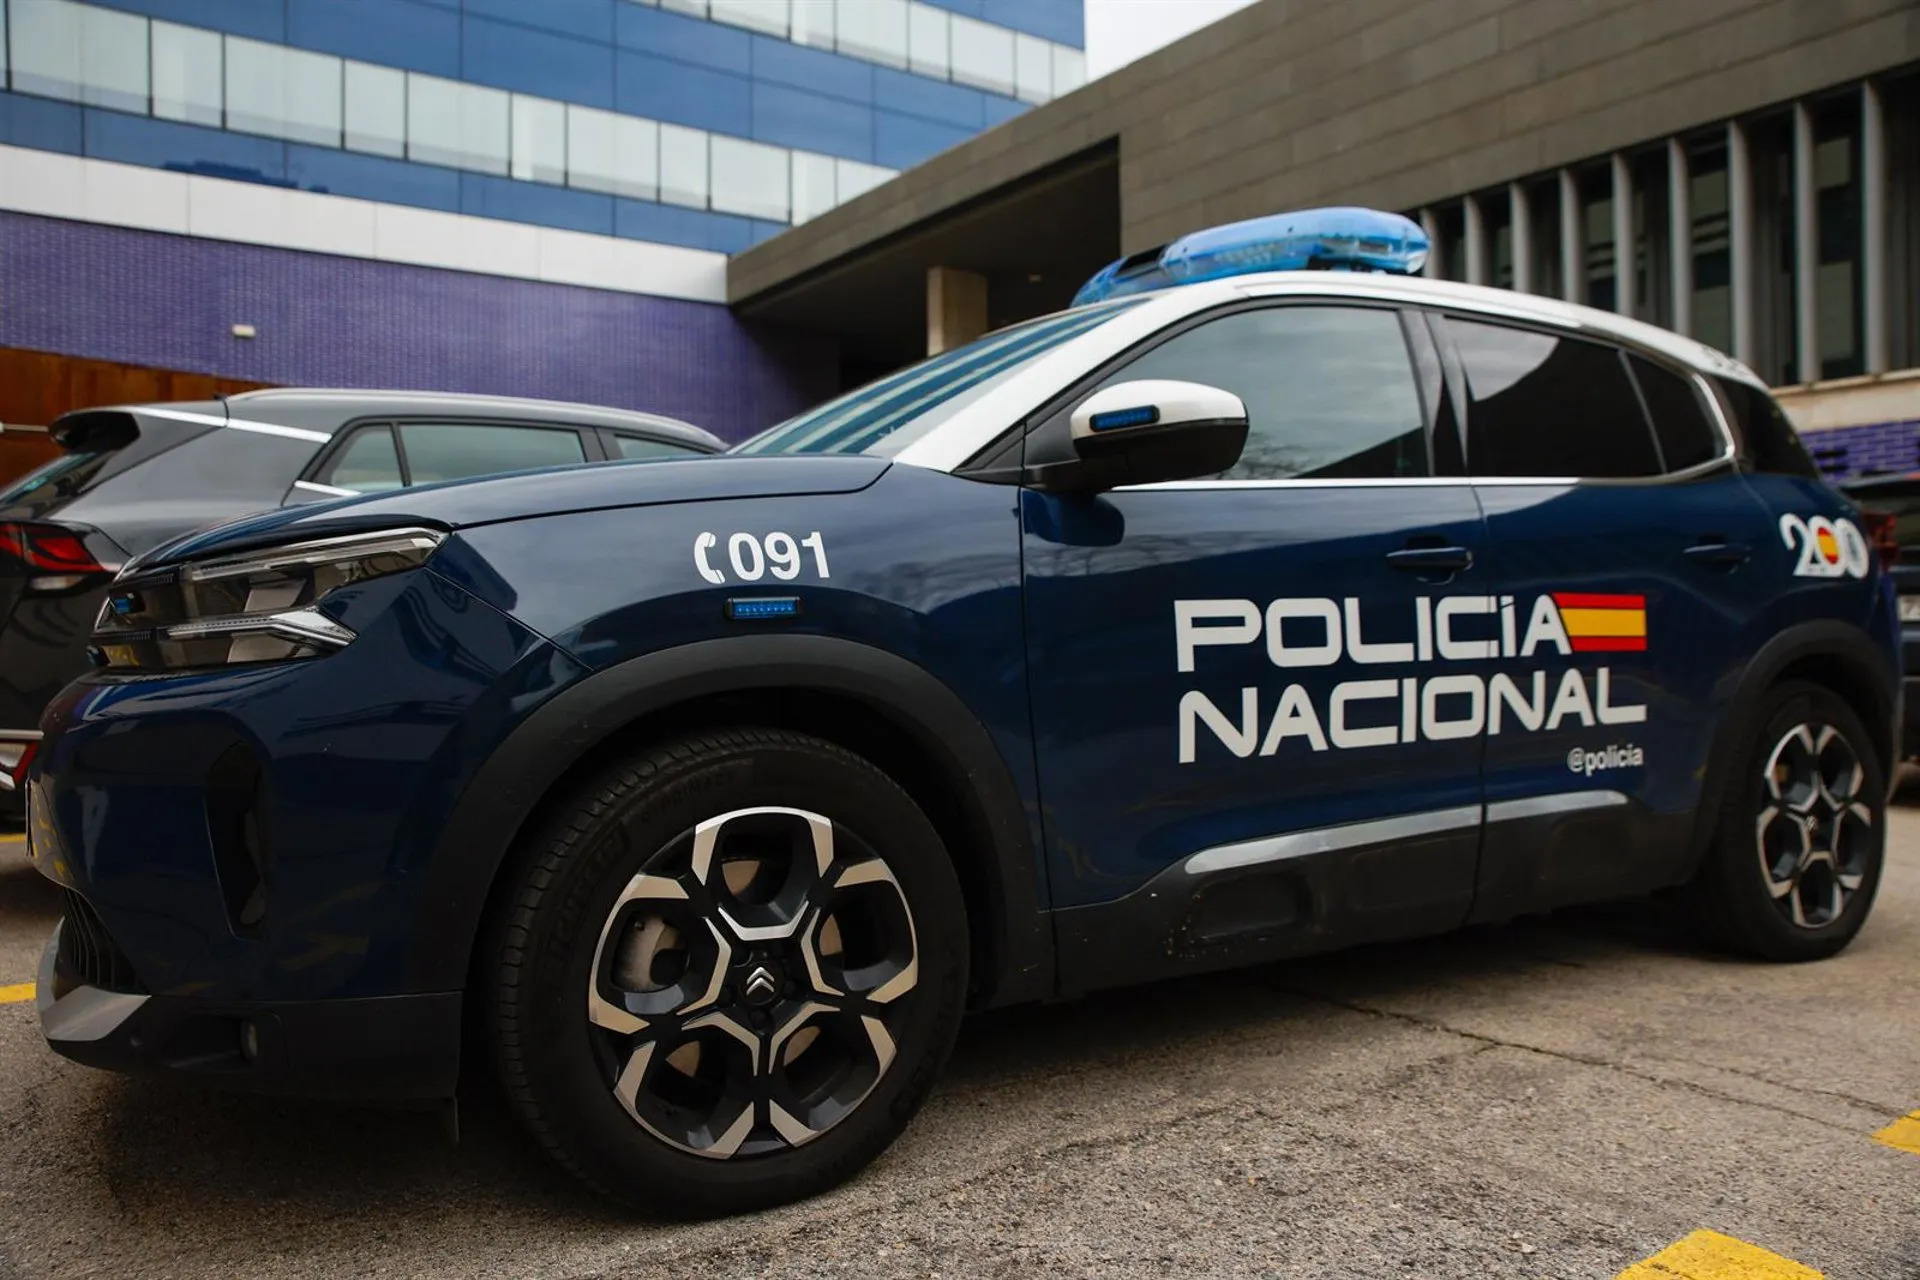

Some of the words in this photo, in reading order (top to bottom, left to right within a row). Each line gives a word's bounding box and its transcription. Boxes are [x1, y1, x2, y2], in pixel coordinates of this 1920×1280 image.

[728, 532, 830, 581] 091
[1779, 513, 1869, 579] 200
[1179, 667, 1647, 764] NACIONAL
